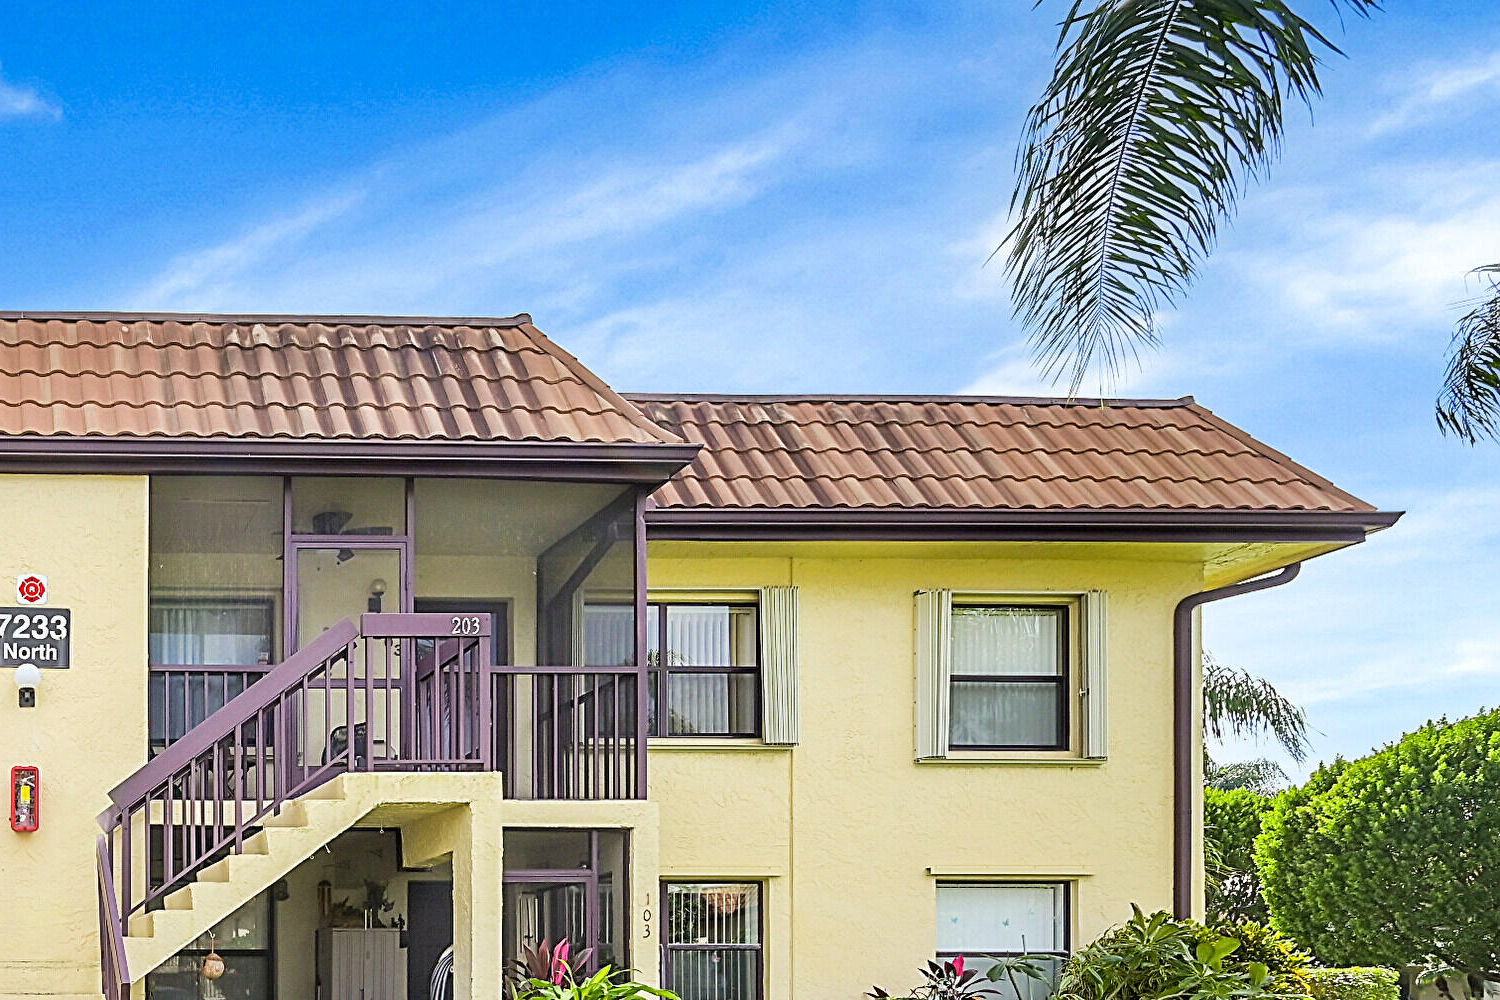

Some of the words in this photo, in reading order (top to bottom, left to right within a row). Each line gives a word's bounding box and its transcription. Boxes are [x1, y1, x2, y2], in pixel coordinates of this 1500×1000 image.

[451, 616, 480, 635] 203
[3, 642, 58, 661] North
[642, 892, 652, 939] 103
